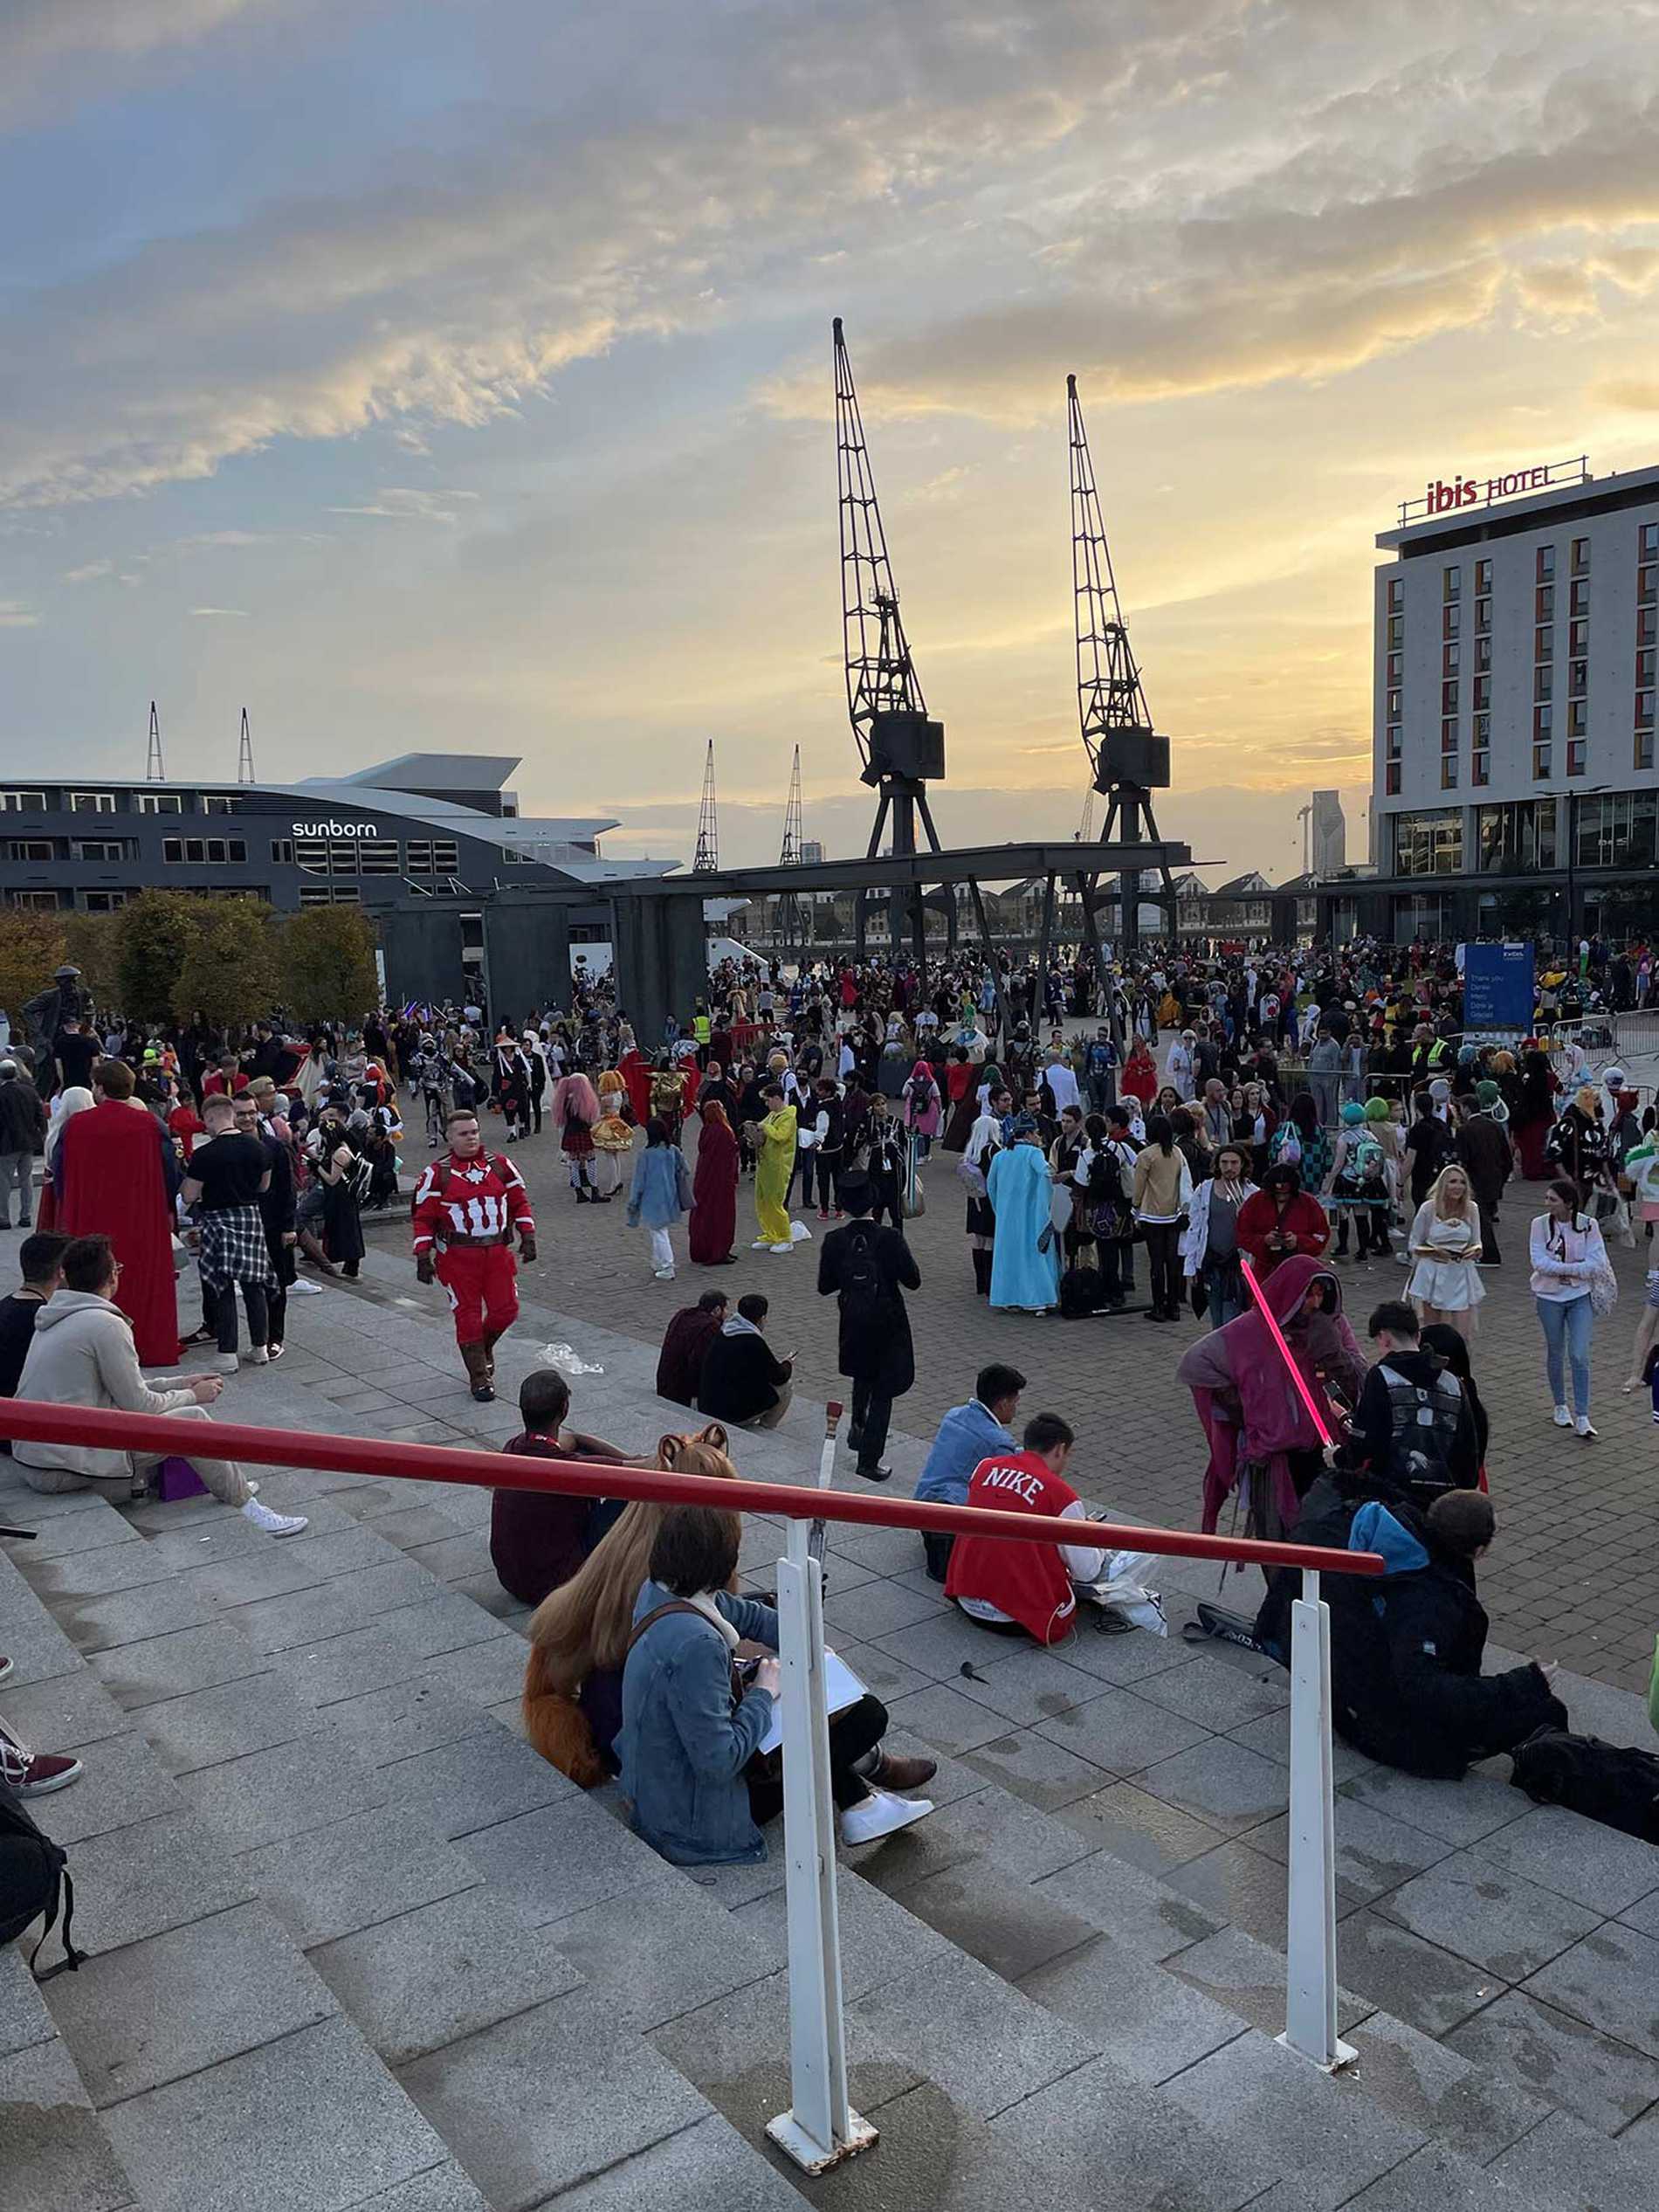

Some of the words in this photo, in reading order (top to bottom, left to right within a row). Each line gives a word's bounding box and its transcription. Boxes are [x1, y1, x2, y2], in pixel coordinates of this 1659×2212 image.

[1427, 476, 1477, 515] ibis
[1488, 465, 1556, 500] HOTEL
[292, 819, 377, 837] sunborn
[981, 1466, 1045, 1506] NIKE
